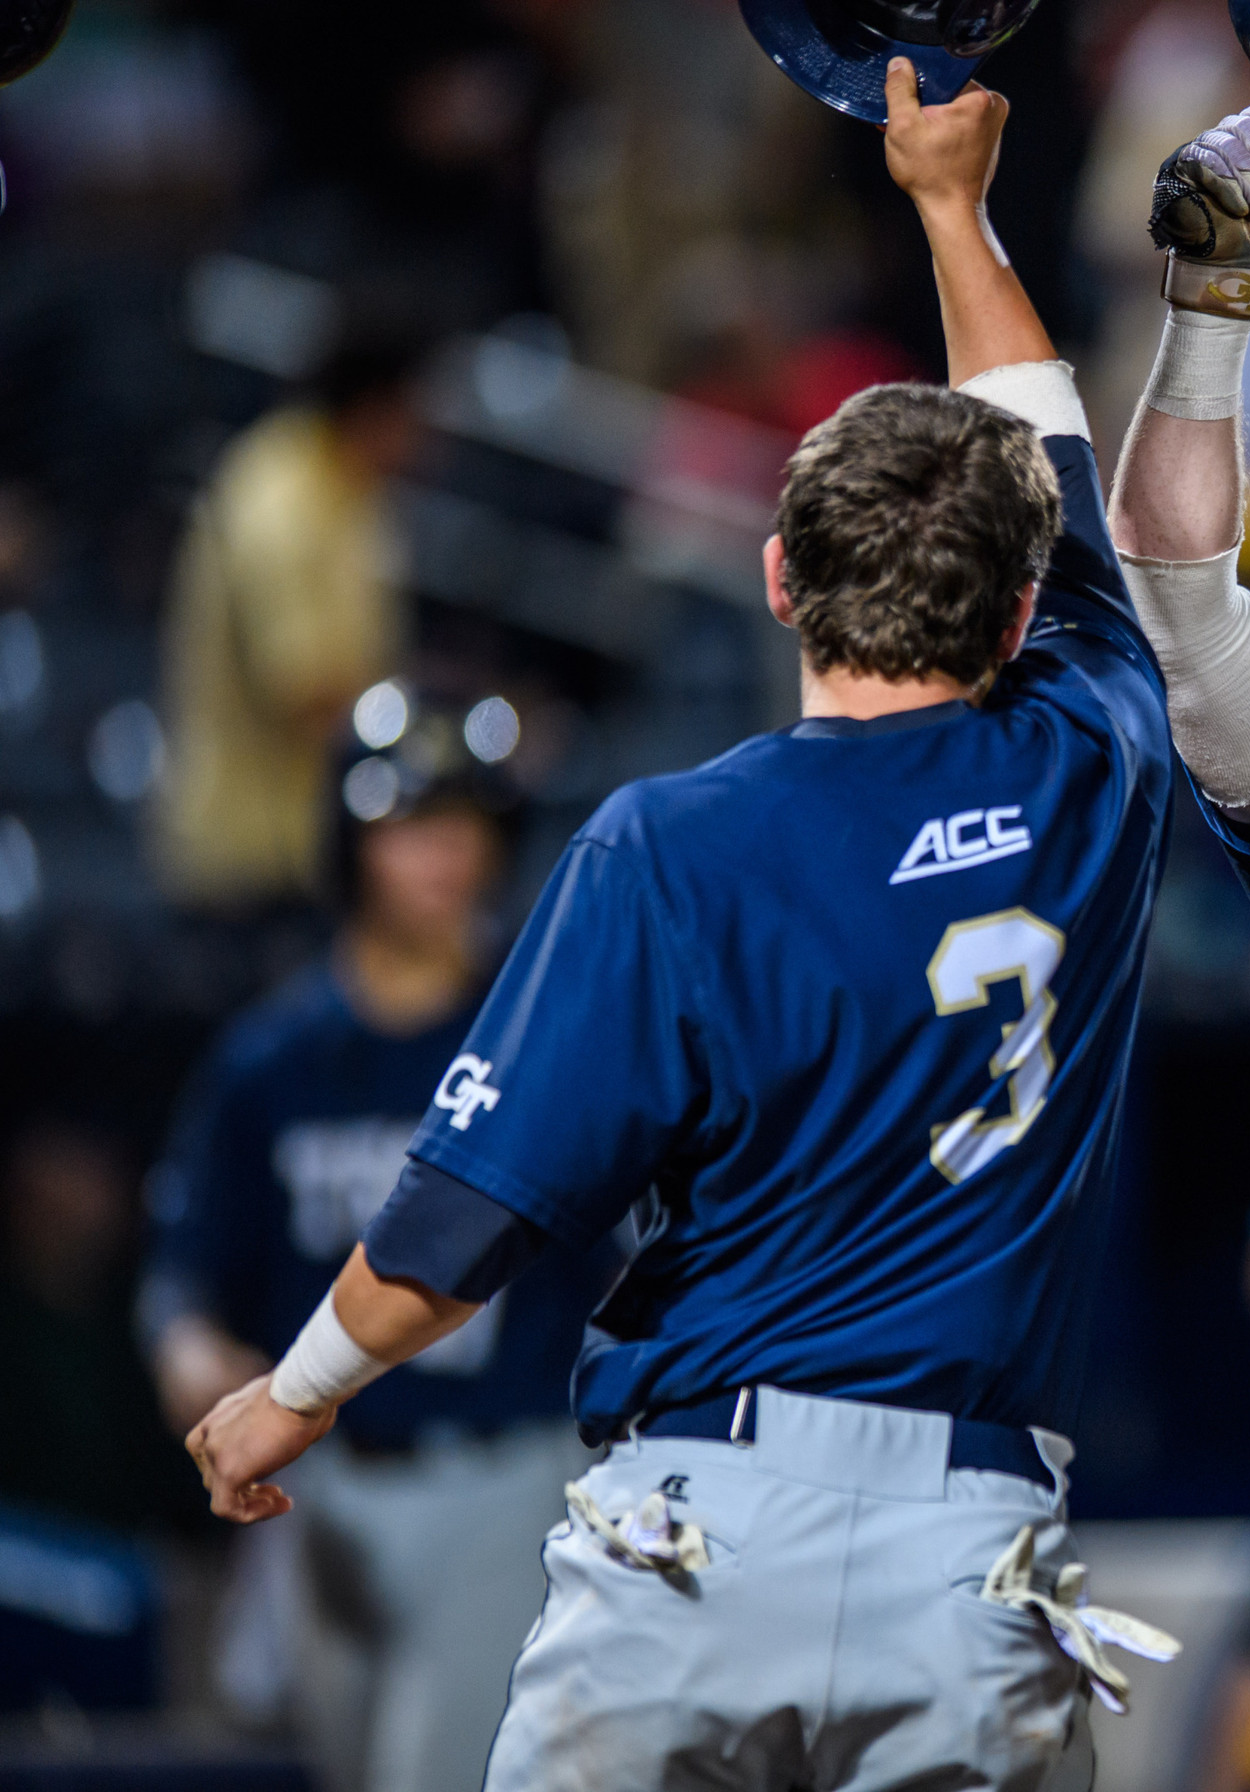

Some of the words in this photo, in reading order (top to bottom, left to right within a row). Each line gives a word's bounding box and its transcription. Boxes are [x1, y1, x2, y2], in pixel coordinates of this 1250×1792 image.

[895, 805, 1032, 878] ACC
[926, 906, 1066, 1185] 3
[434, 1052, 501, 1131] GT
